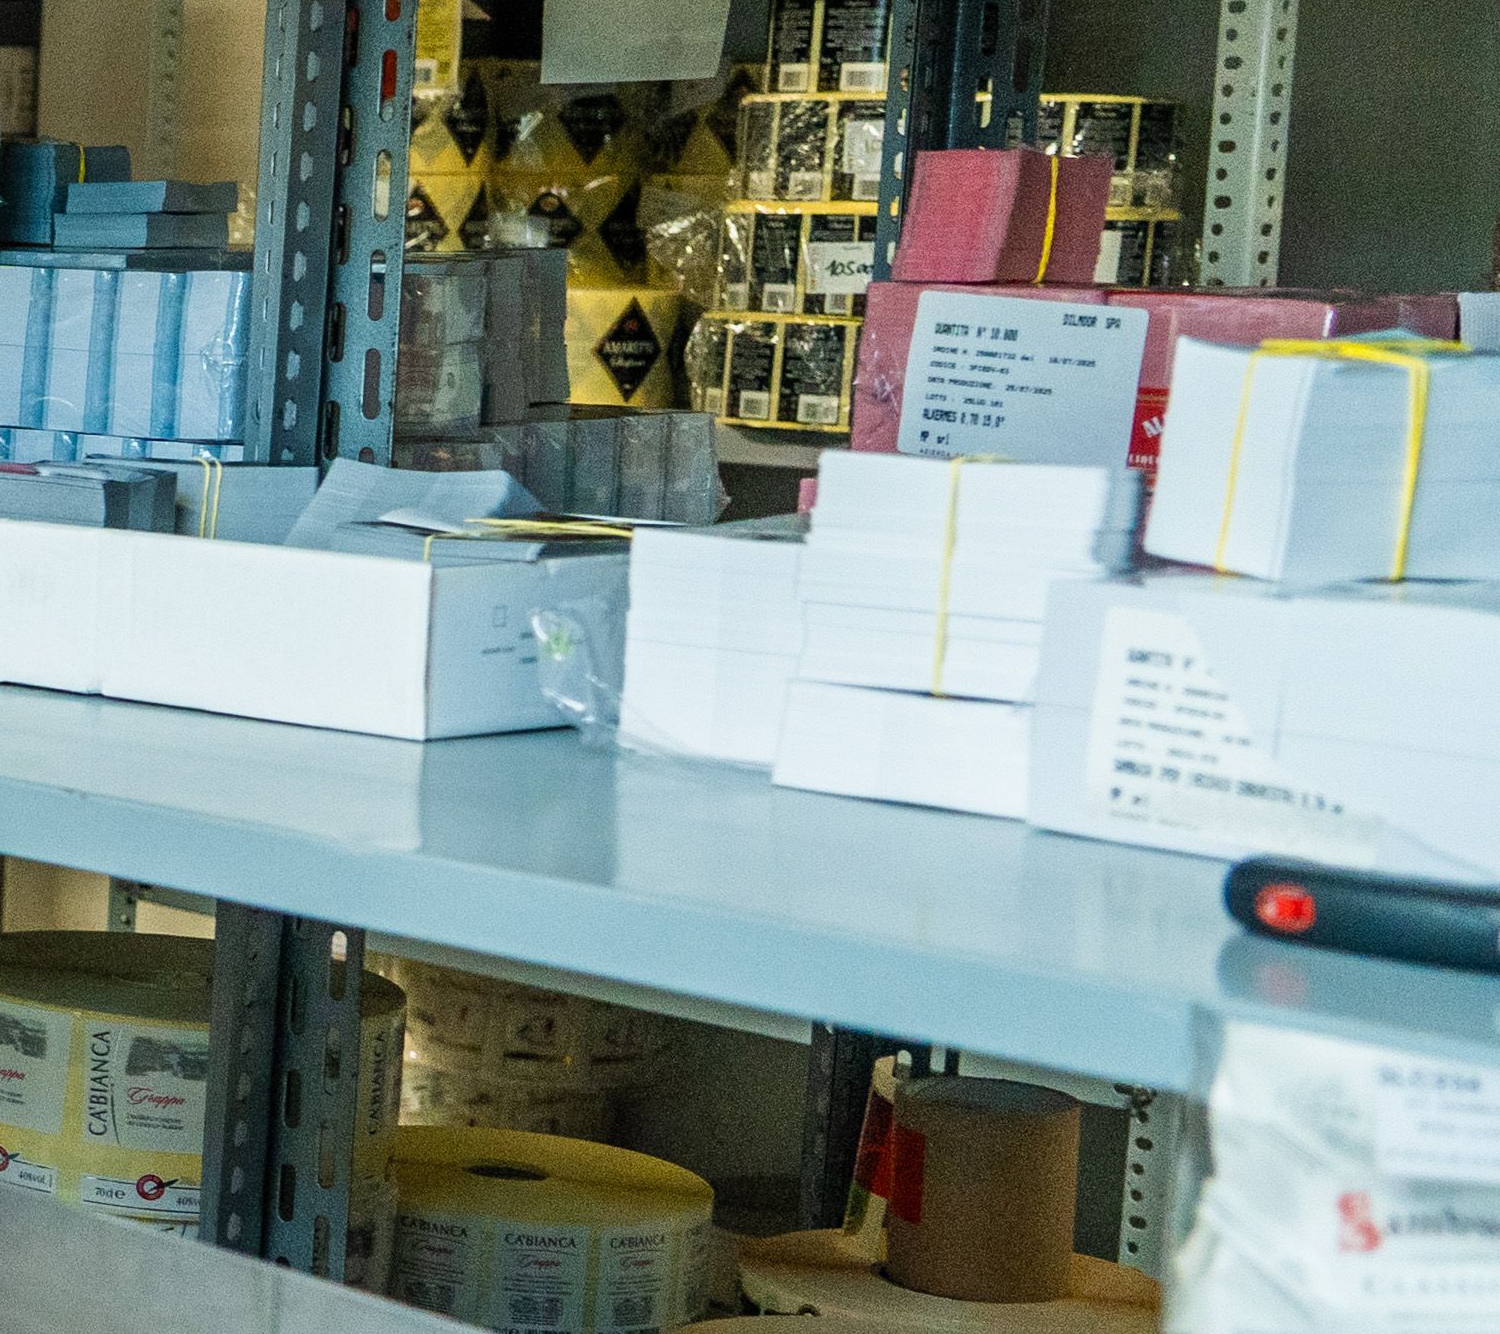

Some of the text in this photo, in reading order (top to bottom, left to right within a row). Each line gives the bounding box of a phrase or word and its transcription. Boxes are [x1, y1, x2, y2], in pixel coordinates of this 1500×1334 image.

[1062, 314, 1098, 329] DILMOOR
[922, 408, 957, 423] ALKERMES
[88, 1030, 112, 1136] CA'BIANCA
[126, 1086, 186, 1109] Grappa
[504, 1233, 577, 1249] CA'BIANCA
